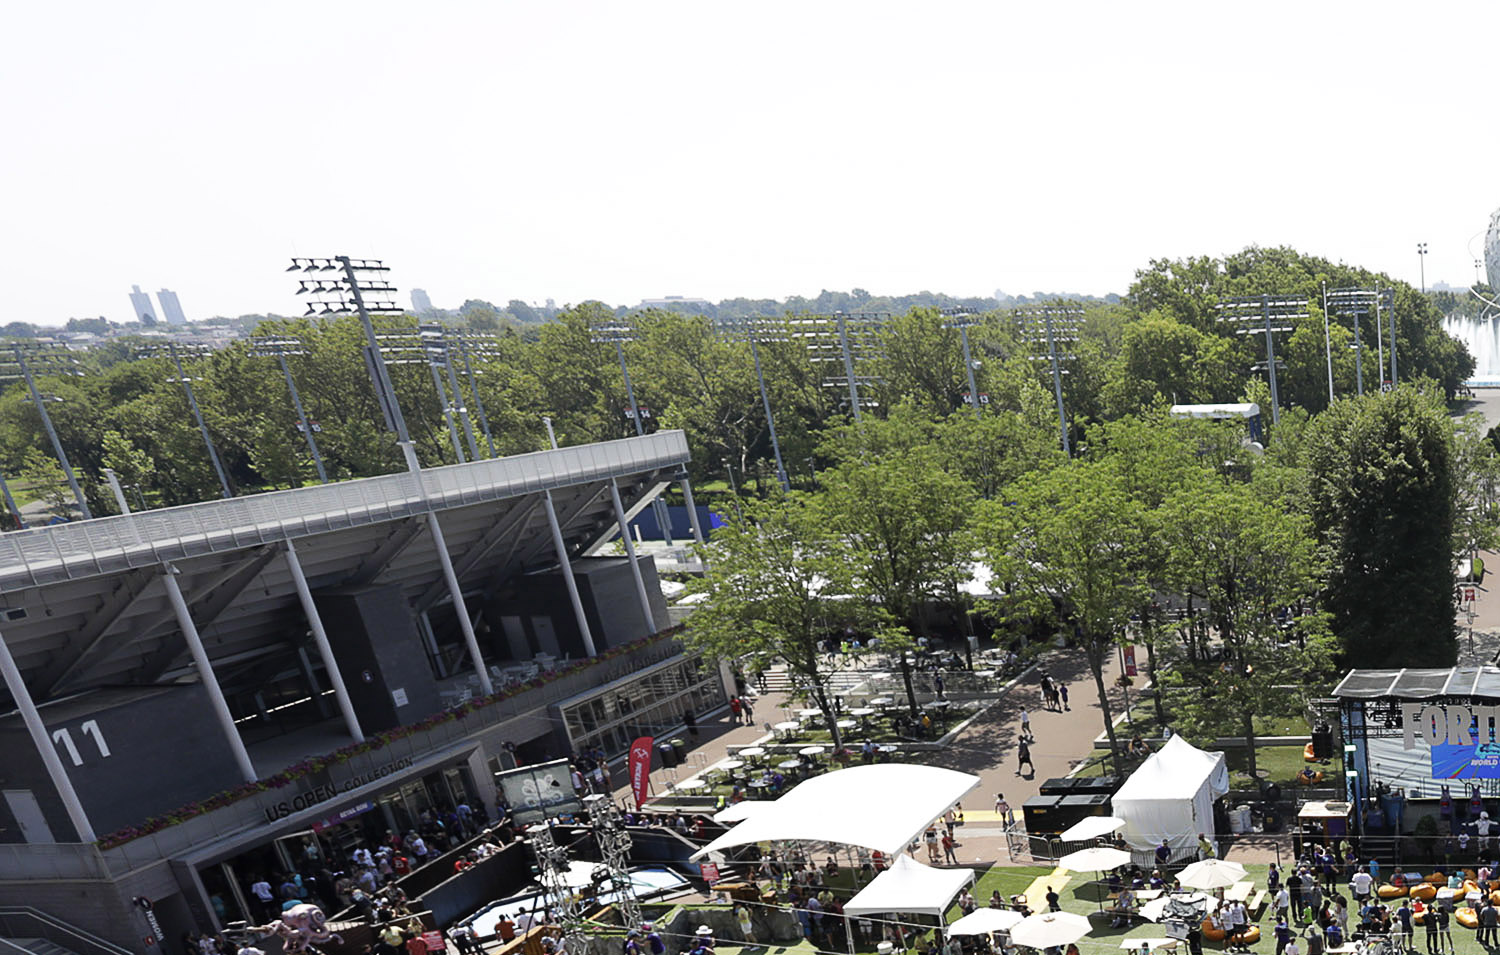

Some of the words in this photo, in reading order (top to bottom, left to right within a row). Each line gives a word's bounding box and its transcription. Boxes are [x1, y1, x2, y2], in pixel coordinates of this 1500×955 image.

[52, 719, 111, 767] 11
[1470, 758, 1499, 767] WORLD
[264, 801, 291, 823] US
[292, 782, 339, 811] OPEN
[343, 756, 415, 792] COLLECTION
